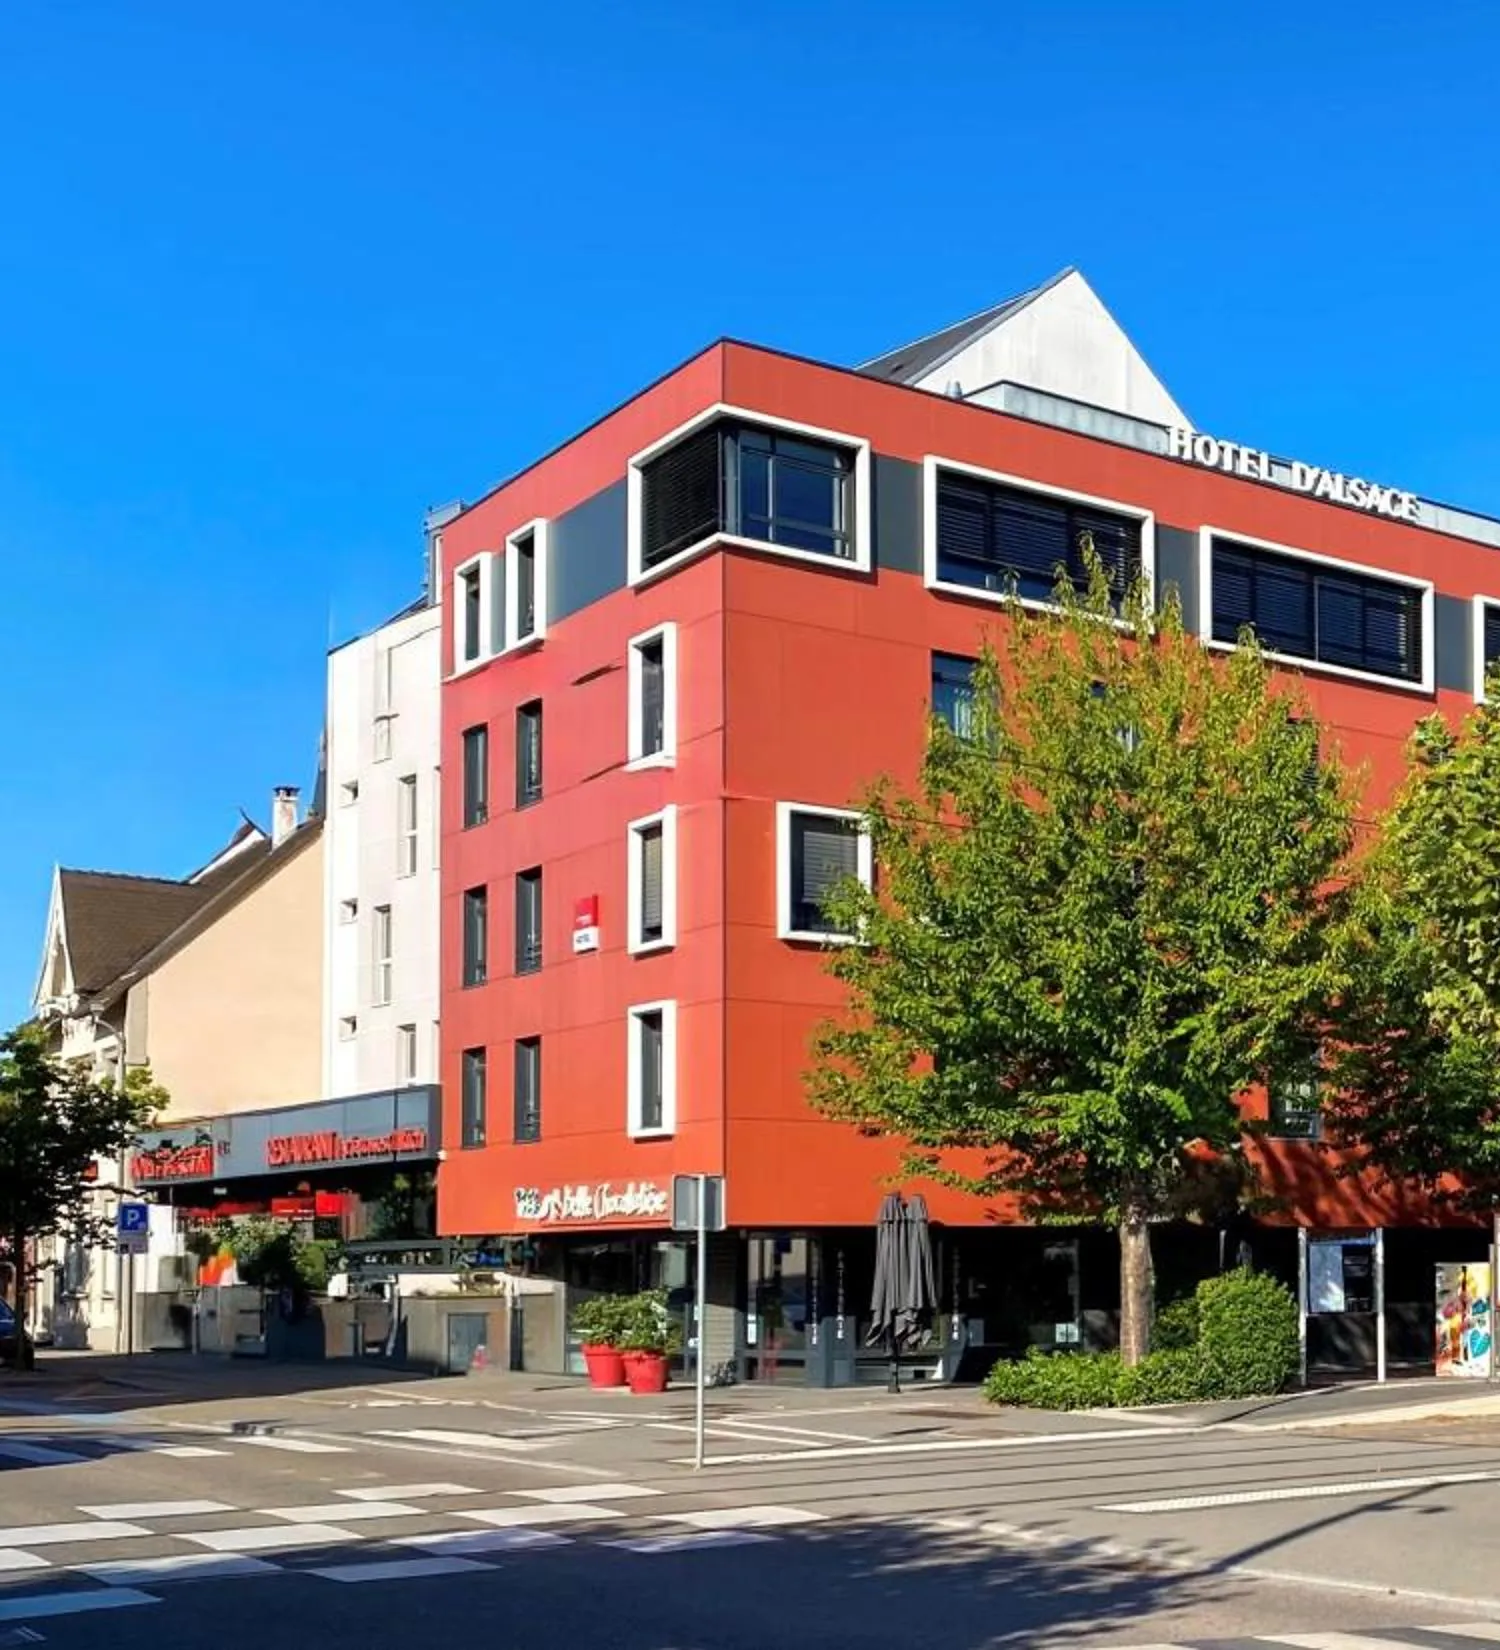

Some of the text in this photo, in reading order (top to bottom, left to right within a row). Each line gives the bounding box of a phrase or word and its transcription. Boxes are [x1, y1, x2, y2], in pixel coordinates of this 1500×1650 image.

[1167, 424, 1420, 521] HOTEL D'ALSACE
[127, 1208, 140, 1225] P
